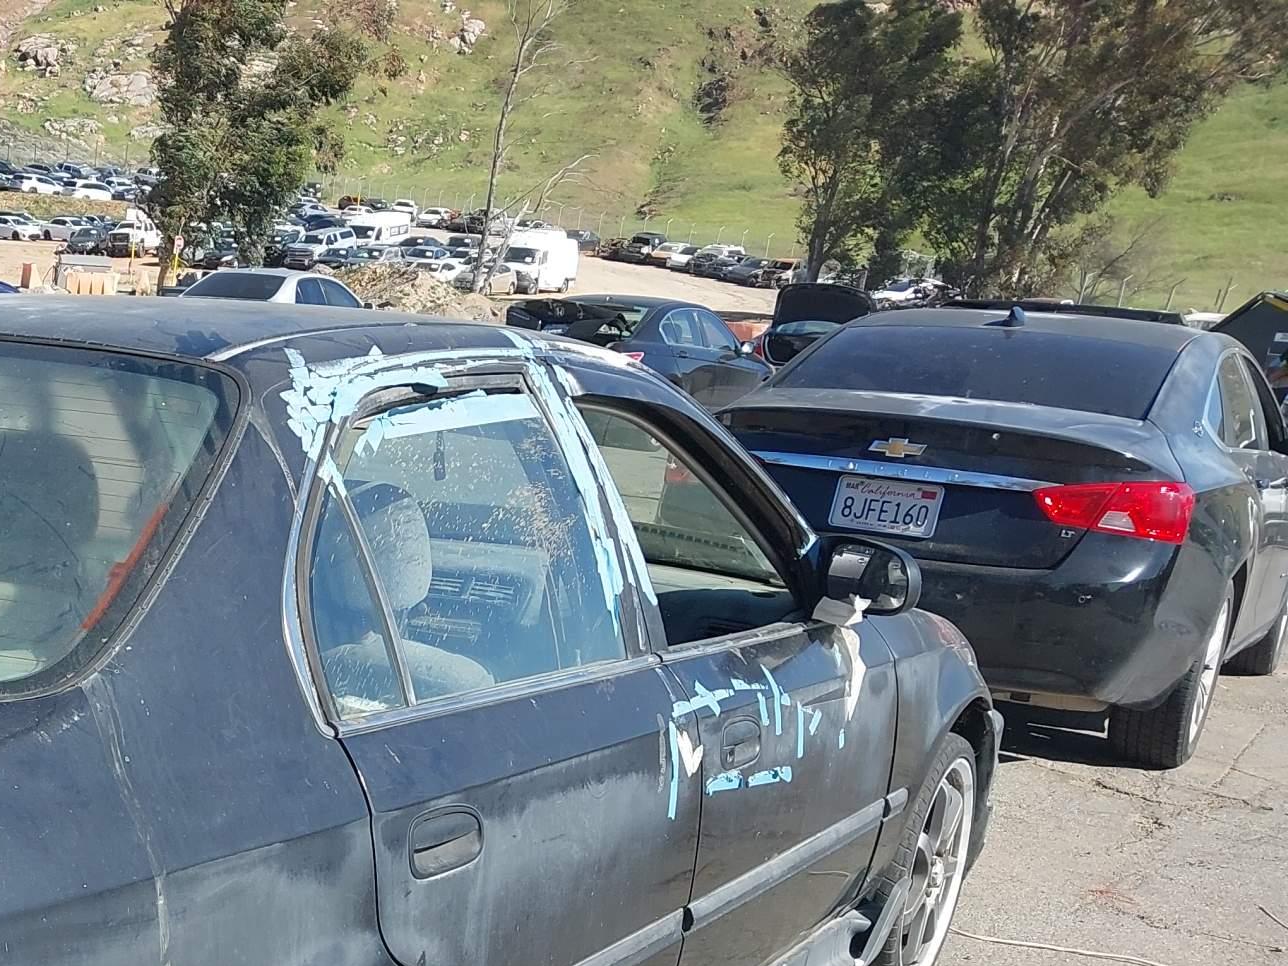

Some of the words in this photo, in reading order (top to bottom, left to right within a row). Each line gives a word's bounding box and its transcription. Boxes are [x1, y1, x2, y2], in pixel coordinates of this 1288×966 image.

[861, 483, 916, 499] California
[840, 496, 930, 528] 8JFE160
[1060, 529, 1076, 538] LT
